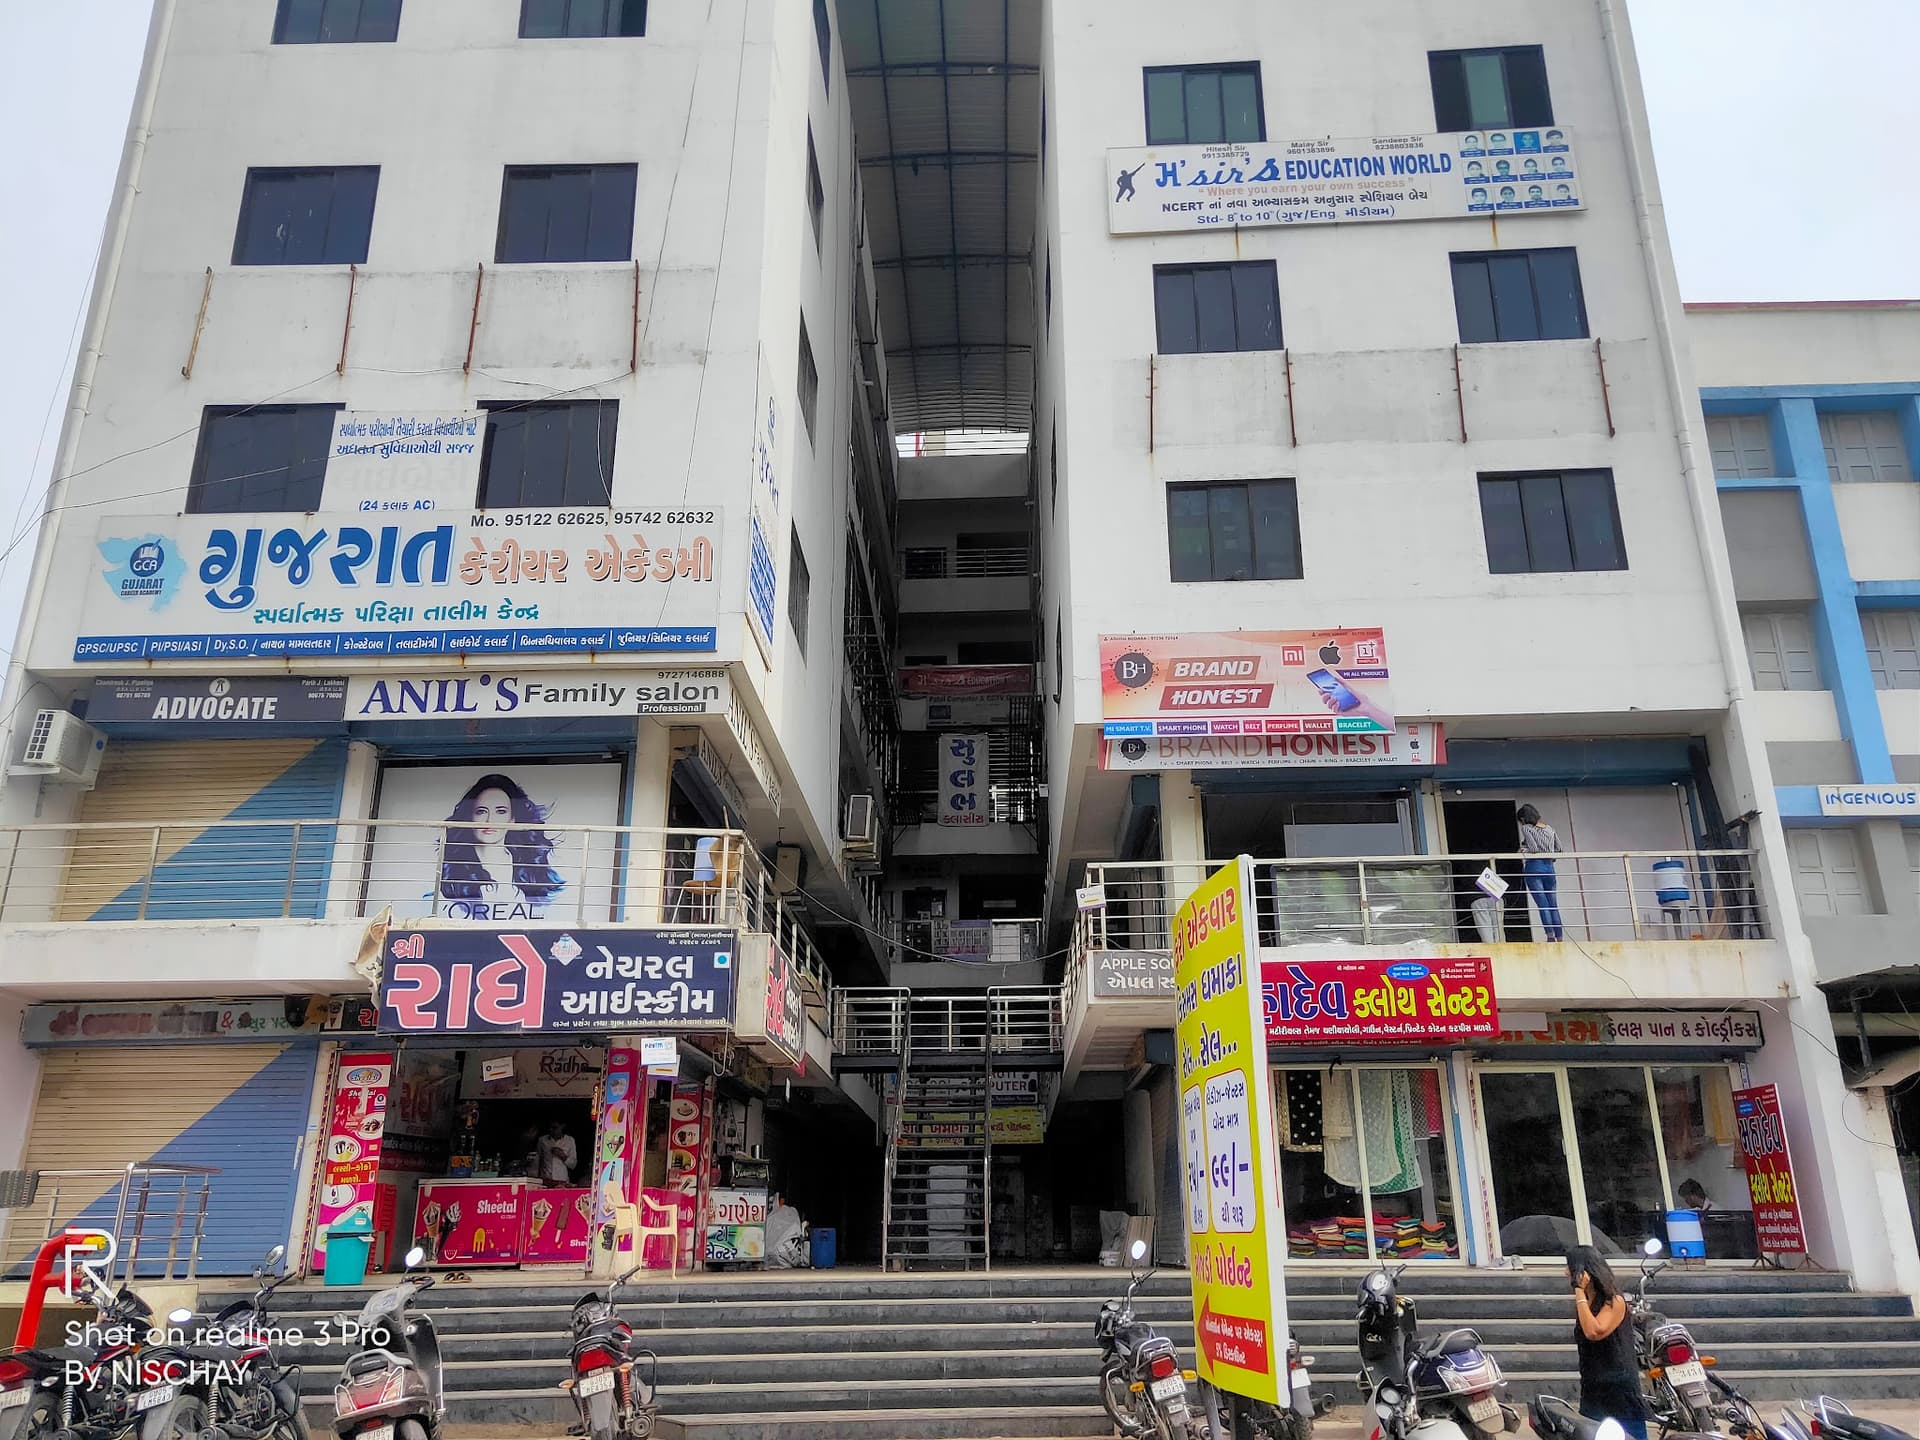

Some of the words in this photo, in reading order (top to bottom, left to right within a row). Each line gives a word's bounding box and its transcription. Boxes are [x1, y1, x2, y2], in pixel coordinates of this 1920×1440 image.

[1285, 156, 1385, 181] EDUCATION
[1389, 153, 1453, 175] WORLD
[1247, 186, 1269, 197] you
[1271, 184, 1297, 194] earn
[1300, 183, 1325, 195] your
[1329, 182, 1354, 191] own
[1162, 201, 1205, 212] NCERT
[1240, 213, 1252, 222] to
[413, 499, 436, 511] AC)
[471, 515, 500, 528] Mo.
[504, 513, 552, 527] 95122
[557, 512, 610, 528] 62625,
[614, 511, 662, 525] 95742
[666, 511, 715, 525] 62632
[132, 559, 158, 571] GCA
[199, 526, 456, 611] ગુજરાત
[121, 577, 165, 590] GUJARAT
[77, 642, 139, 654] GPSC/UPSC
[151, 640, 202, 652] PI/PSI/ASI
[657, 669, 725, 680] 9727146888
[1174, 659, 1255, 677] BRAND
[523, 682, 627, 707] Family
[635, 680, 720, 702] salon
[1170, 687, 1263, 706] HONEST
[152, 696, 279, 721] ADVOCATE
[641, 702, 703, 714] Professional
[1304, 722, 1332, 730] WALLET
[1825, 792, 1917, 805] INGENIOUS
[586, 946, 695, 980] નેચરલ
[1100, 958, 1147, 971] APPLE
[1107, 973, 1155, 989] એપલ
[1426, 973, 1492, 1017] સેન્ટર
[1650, 1021, 1676, 1037] પાન
[1682, 1022, 1691, 1036] &
[476, 1198, 517, 1216] Sheetal
